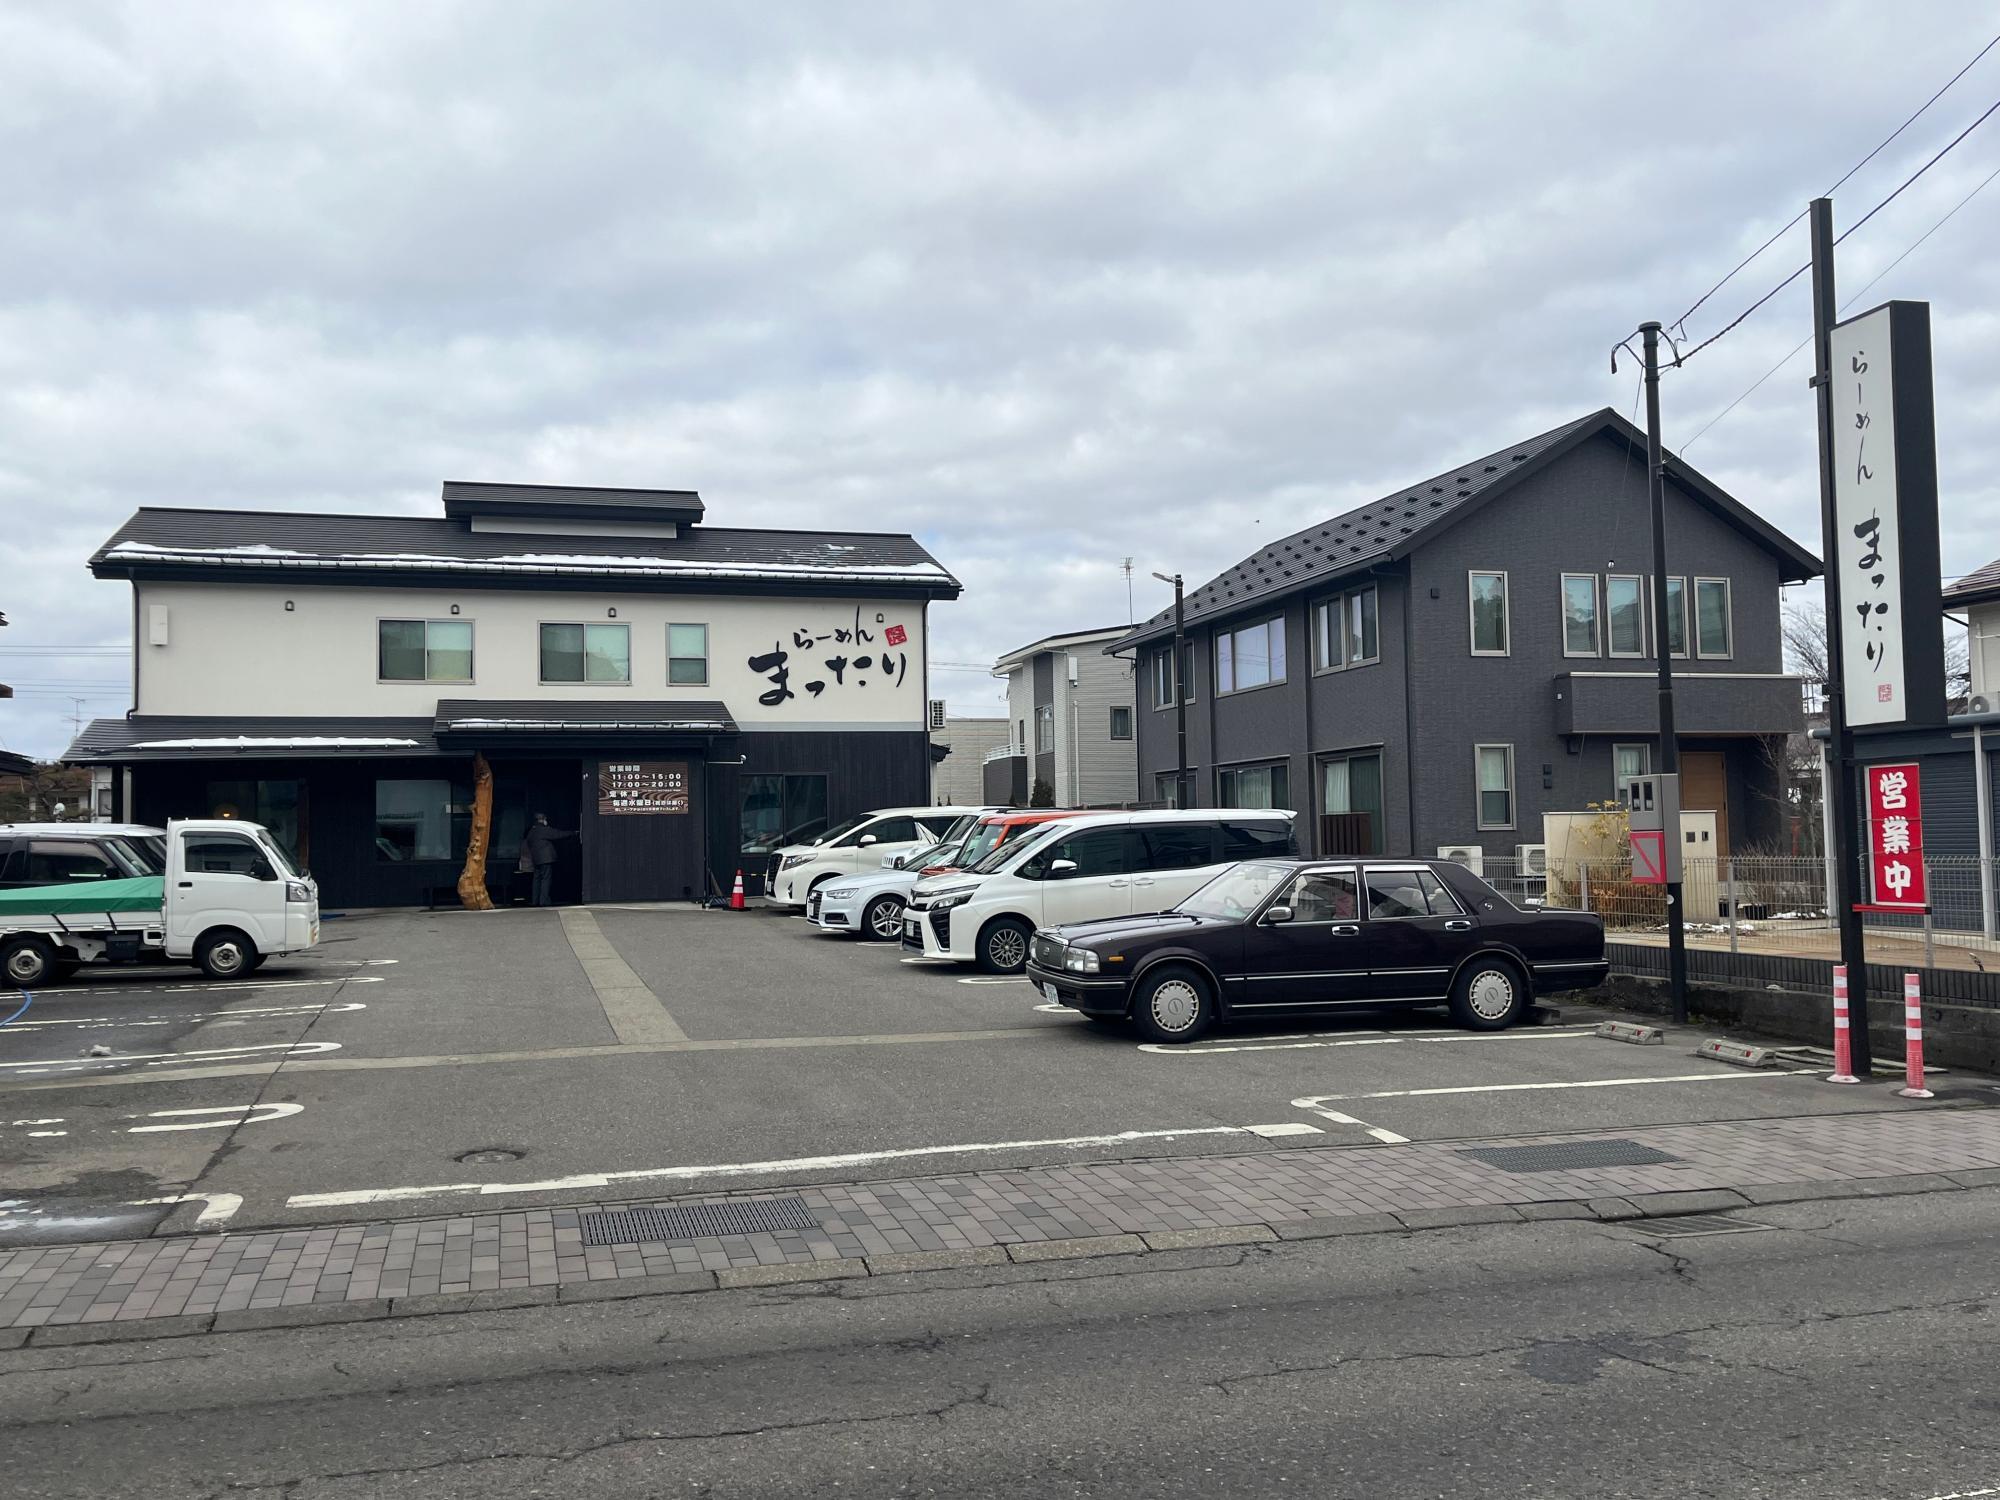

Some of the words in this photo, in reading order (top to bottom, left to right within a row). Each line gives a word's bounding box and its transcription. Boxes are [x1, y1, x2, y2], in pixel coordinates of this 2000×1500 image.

[1851, 350, 1874, 485] らーめん
[793, 605, 874, 650] らーめん
[1853, 508, 1889, 673] まったり
[748, 641, 907, 706] まったり
[609, 790, 638, 798] 定休日
[1879, 771, 1912, 899] 営業中
